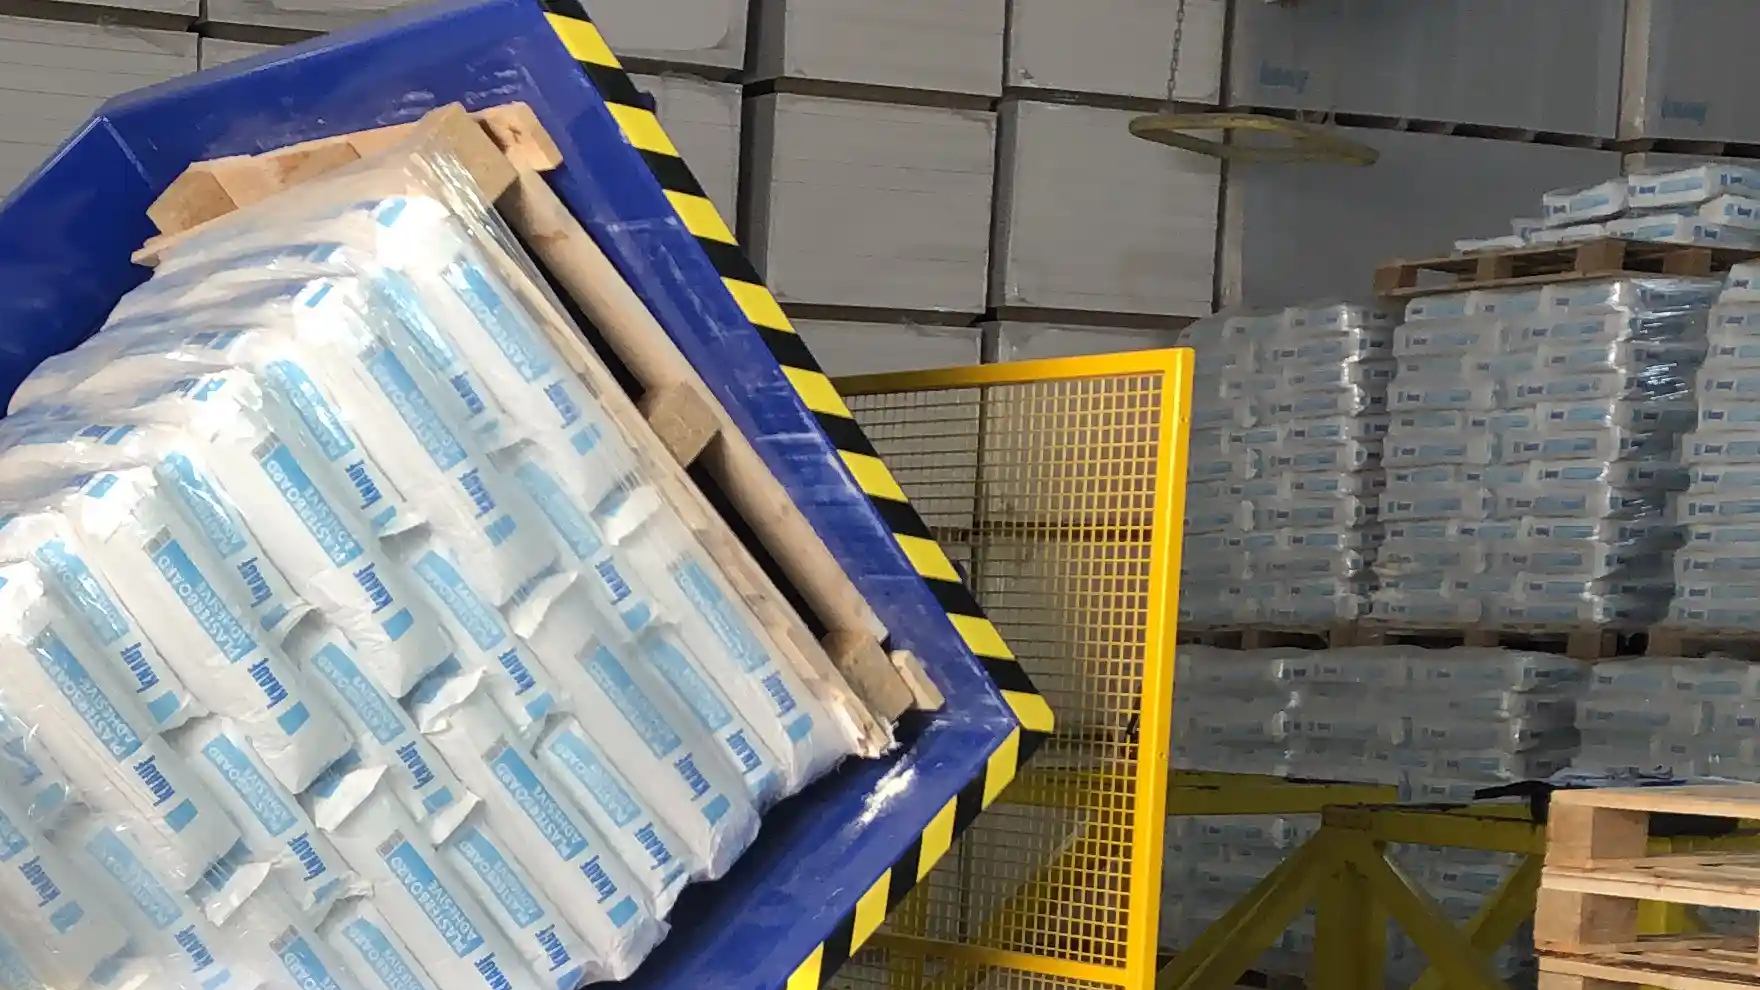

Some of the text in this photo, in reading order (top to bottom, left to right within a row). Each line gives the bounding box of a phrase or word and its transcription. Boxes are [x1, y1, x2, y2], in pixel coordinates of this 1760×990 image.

[342, 460, 381, 508] KNAUF
[265, 458, 346, 563] PLASTERBOARD
[156, 553, 241, 658] PLASTERBOARD
[235, 556, 273, 607] KNAUF
[352, 562, 393, 612] KNAUF
[118, 641, 159, 693] KNAUF
[245, 657, 289, 708] KNAUF
[132, 755, 175, 805] KNAUF
[395, 740, 435, 789] KNAUF
[286, 831, 326, 881] KNAUF
[632, 823, 672, 870] KNAUF
[578, 854, 618, 901] KNAUF
[389, 854, 467, 953] PLASTERBOARD
[426, 877, 477, 941] ADHESIVE
[174, 924, 213, 972] KNAUF
[533, 924, 570, 971] KNAUF
